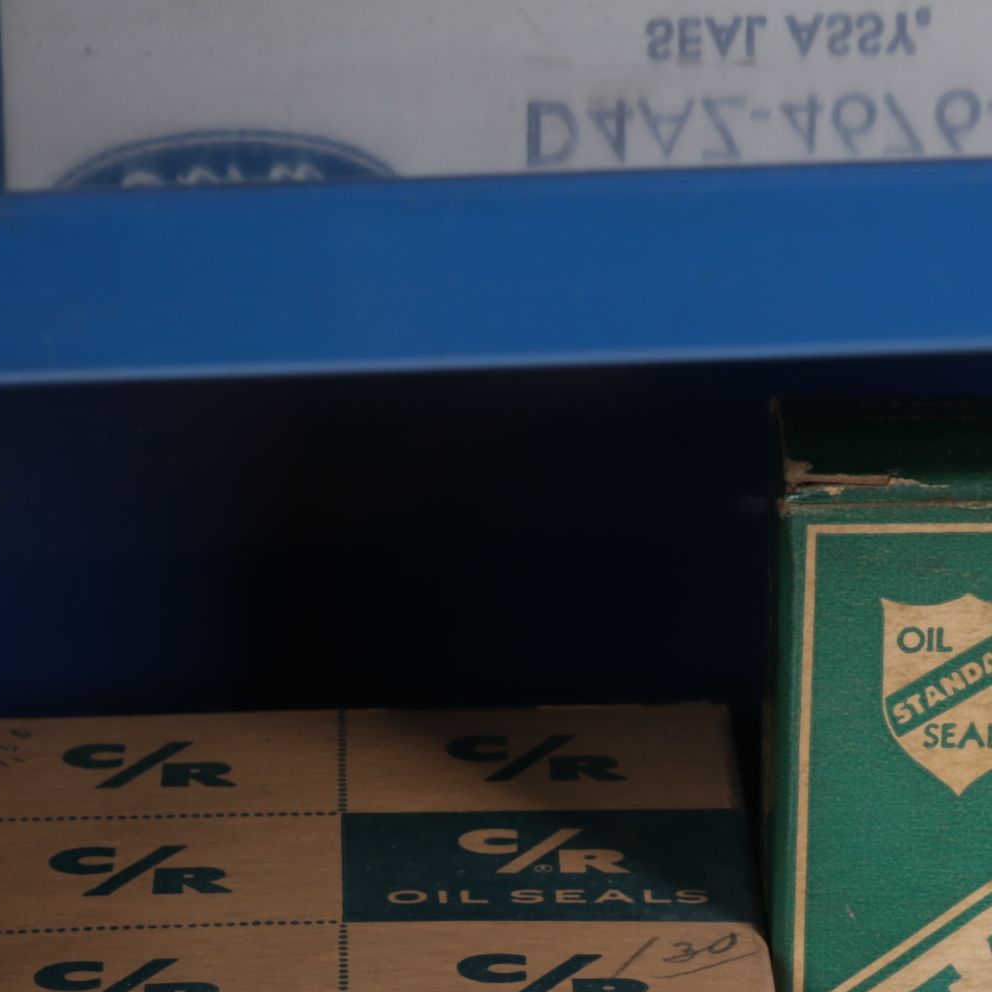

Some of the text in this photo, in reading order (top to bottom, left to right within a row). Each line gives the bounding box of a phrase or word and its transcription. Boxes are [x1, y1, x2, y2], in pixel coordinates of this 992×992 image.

[897, 626, 953, 653] OIL
[62, 741, 237, 789] C/R
[49, 845, 234, 897] C/R
[388, 888, 709, 906] OIL SEALS
